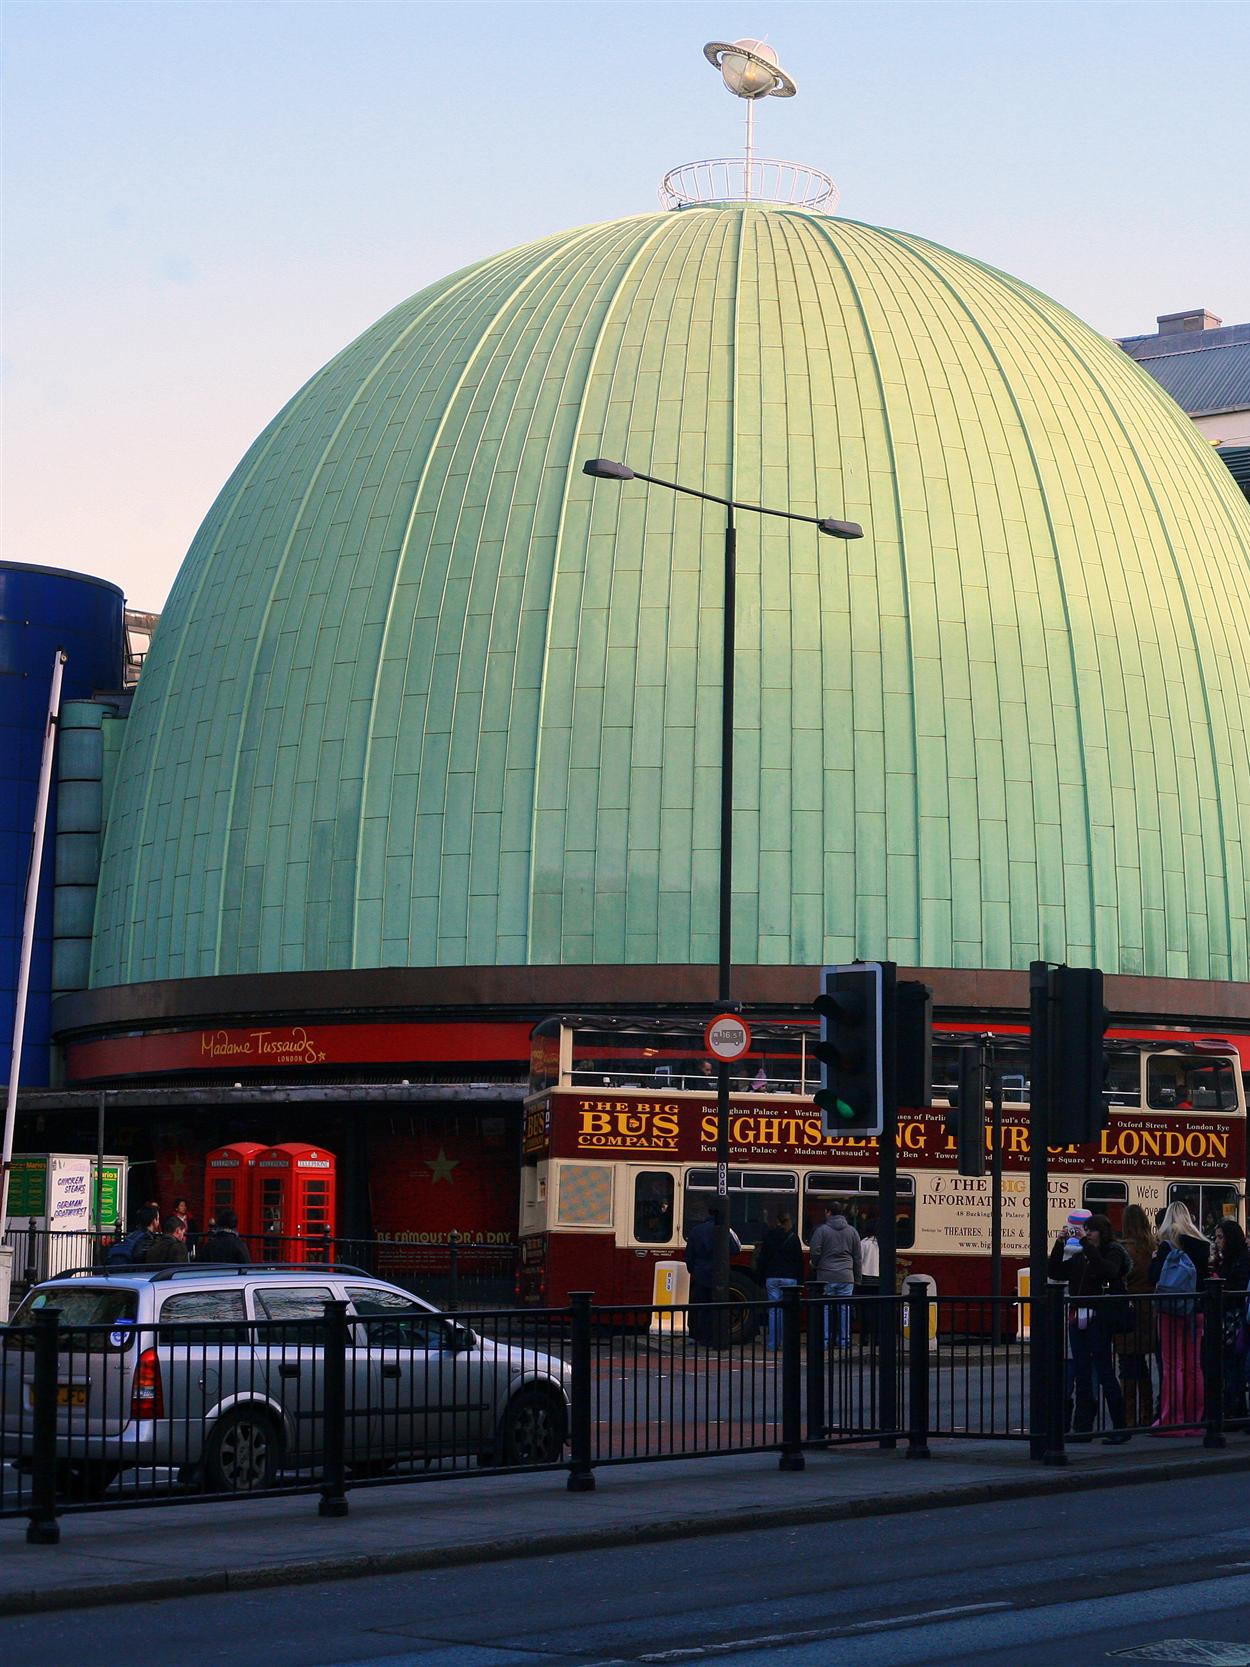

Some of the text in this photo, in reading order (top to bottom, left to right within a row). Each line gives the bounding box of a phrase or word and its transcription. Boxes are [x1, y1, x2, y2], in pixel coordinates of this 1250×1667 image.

[202, 1027, 317, 1064] Madame Tussauds
[580, 1101, 680, 1113] THE BIG
[702, 1106, 750, 1115] Bucgham
[754, 1108, 778, 1116] Palace
[578, 1112, 680, 1136] BUS
[578, 1136, 679, 1148] COMPANY
[1098, 1130, 1229, 1158] LONDON
[701, 1145, 748, 1154] Kengton
[794, 1148, 828, 1156] Madame
[1102, 1158, 1138, 1166] Piccadilly
[1202, 1160, 1229, 1168] Gallery
[950, 1179, 987, 1192] THE
[1048, 1182, 1069, 1194] US
[1136, 1185, 1159, 1199] We're
[922, 1194, 1076, 1209] INFORMATON CTRE
[394, 1232, 442, 1243] FAMOUS
[487, 1232, 511, 1244] DAY
[1019, 1229, 1024, 1238] &
